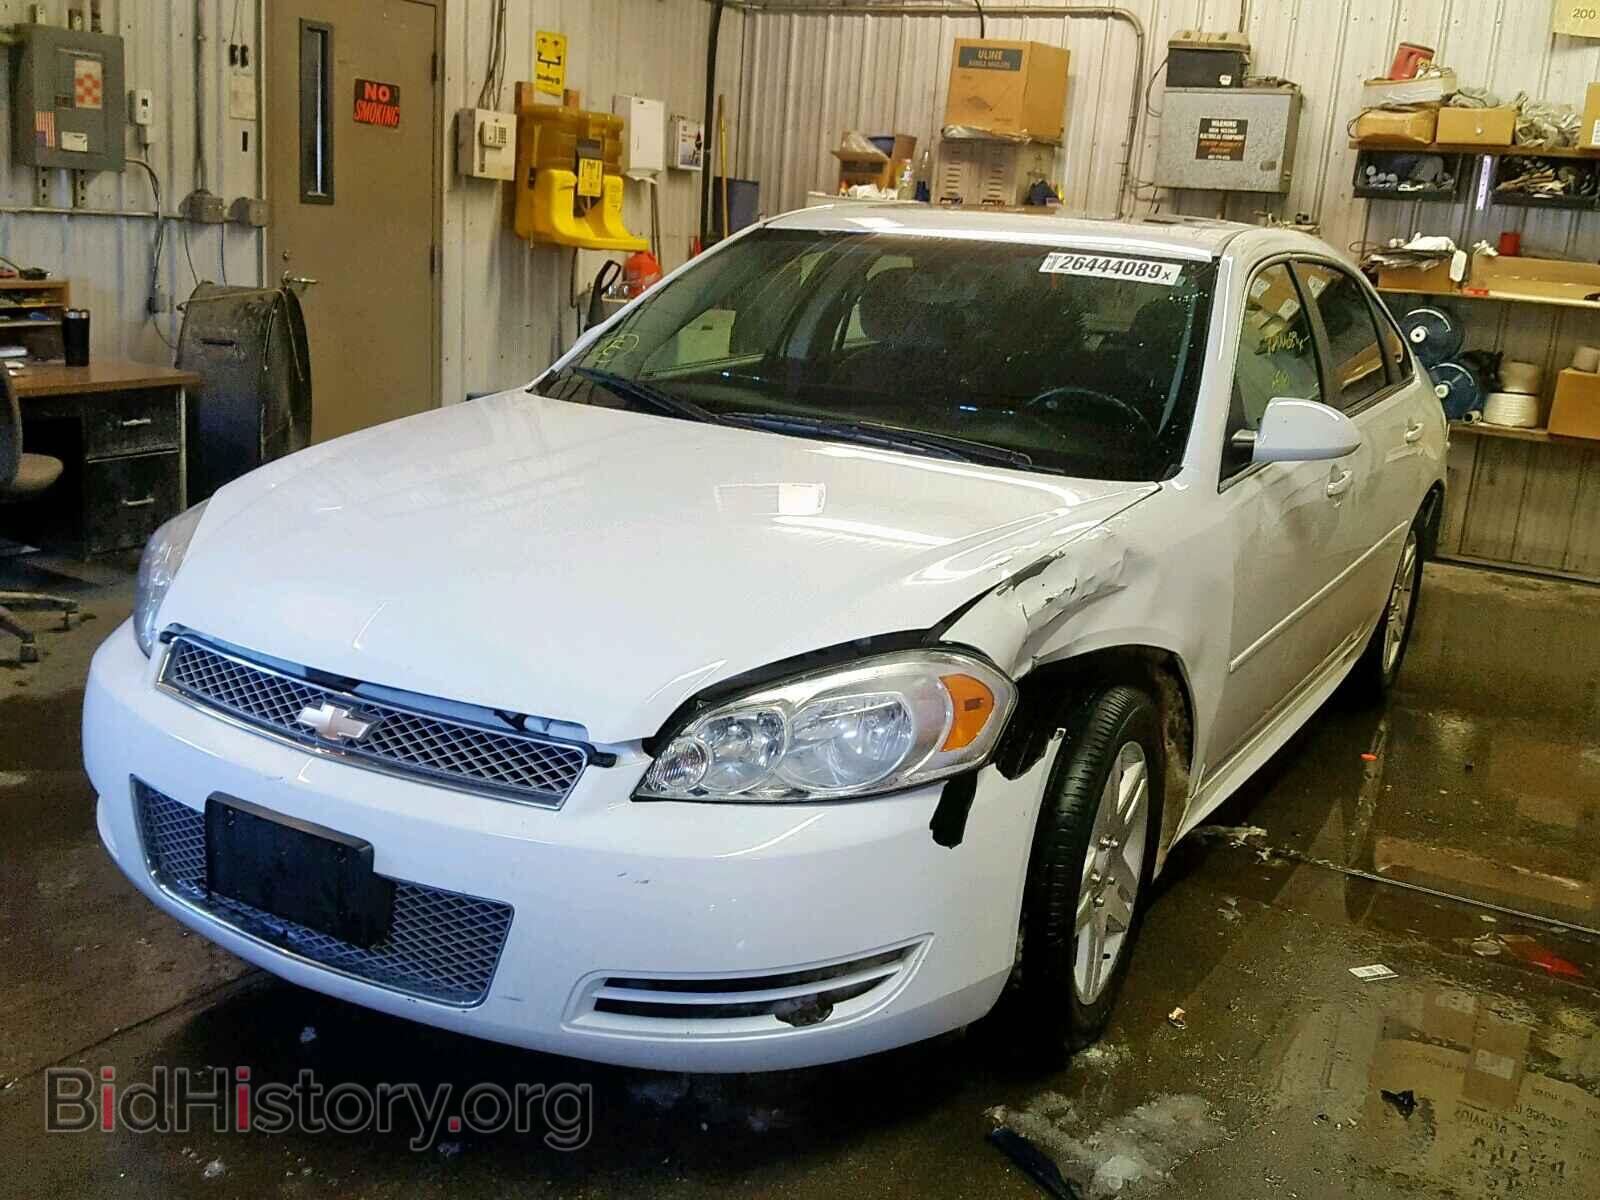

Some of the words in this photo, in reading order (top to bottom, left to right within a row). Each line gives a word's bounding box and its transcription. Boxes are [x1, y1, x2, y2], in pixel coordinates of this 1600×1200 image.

[1572, 8, 1597, 19] 200
[364, 81, 390, 103] NO
[353, 100, 400, 126] SMOKING
